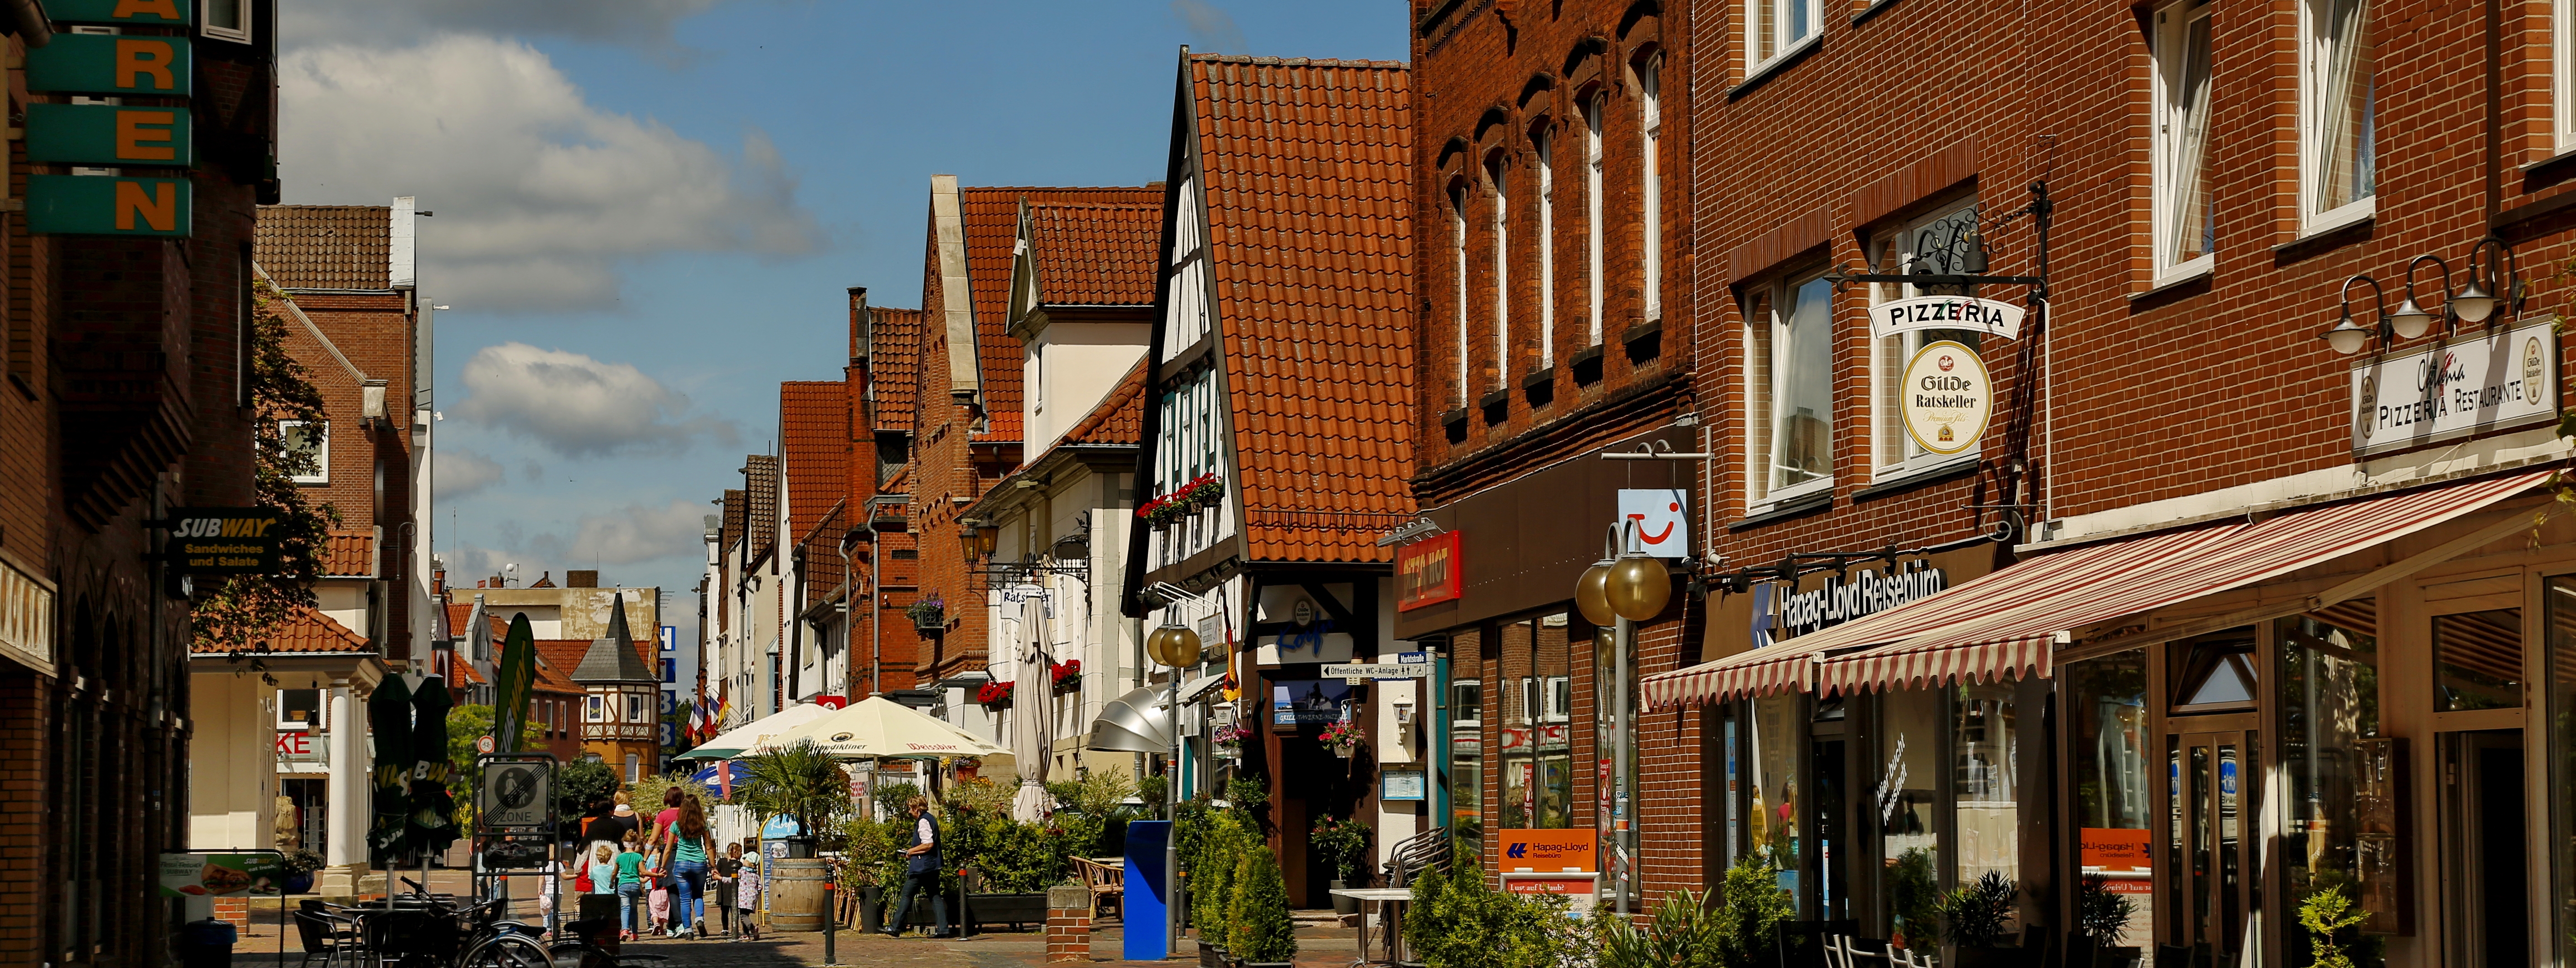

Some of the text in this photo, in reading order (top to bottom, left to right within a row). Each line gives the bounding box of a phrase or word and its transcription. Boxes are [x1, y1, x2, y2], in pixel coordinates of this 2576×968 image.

[1890, 303, 2004, 327] PIZZERIA
[1921, 376, 1972, 392] Gilde
[1916, 394, 1976, 408] Ratskeller
[2380, 380, 2522, 429] PIZZERIA RESTAURANTE
[1923, 410, 1970, 422] Premium Pils
[173, 517, 277, 538] SUBWAY
[185, 544, 264, 554] Sandwiches
[189, 557, 259, 566] und Salate
[1429, 548, 1448, 584] HOT
[1781, 560, 1940, 636] Hapag-Lloyd Reisebüro
[1401, 654, 1424, 663] Marktstraße
[1331, 666, 1398, 676] Öffentliche WC-Anlage
[1877, 732, 1905, 807] Hier bucht
[1883, 761, 1907, 826] Neustadt
[500, 812, 531, 822] ZONE
[1533, 842, 1589, 852] Hapag-Lloyd
